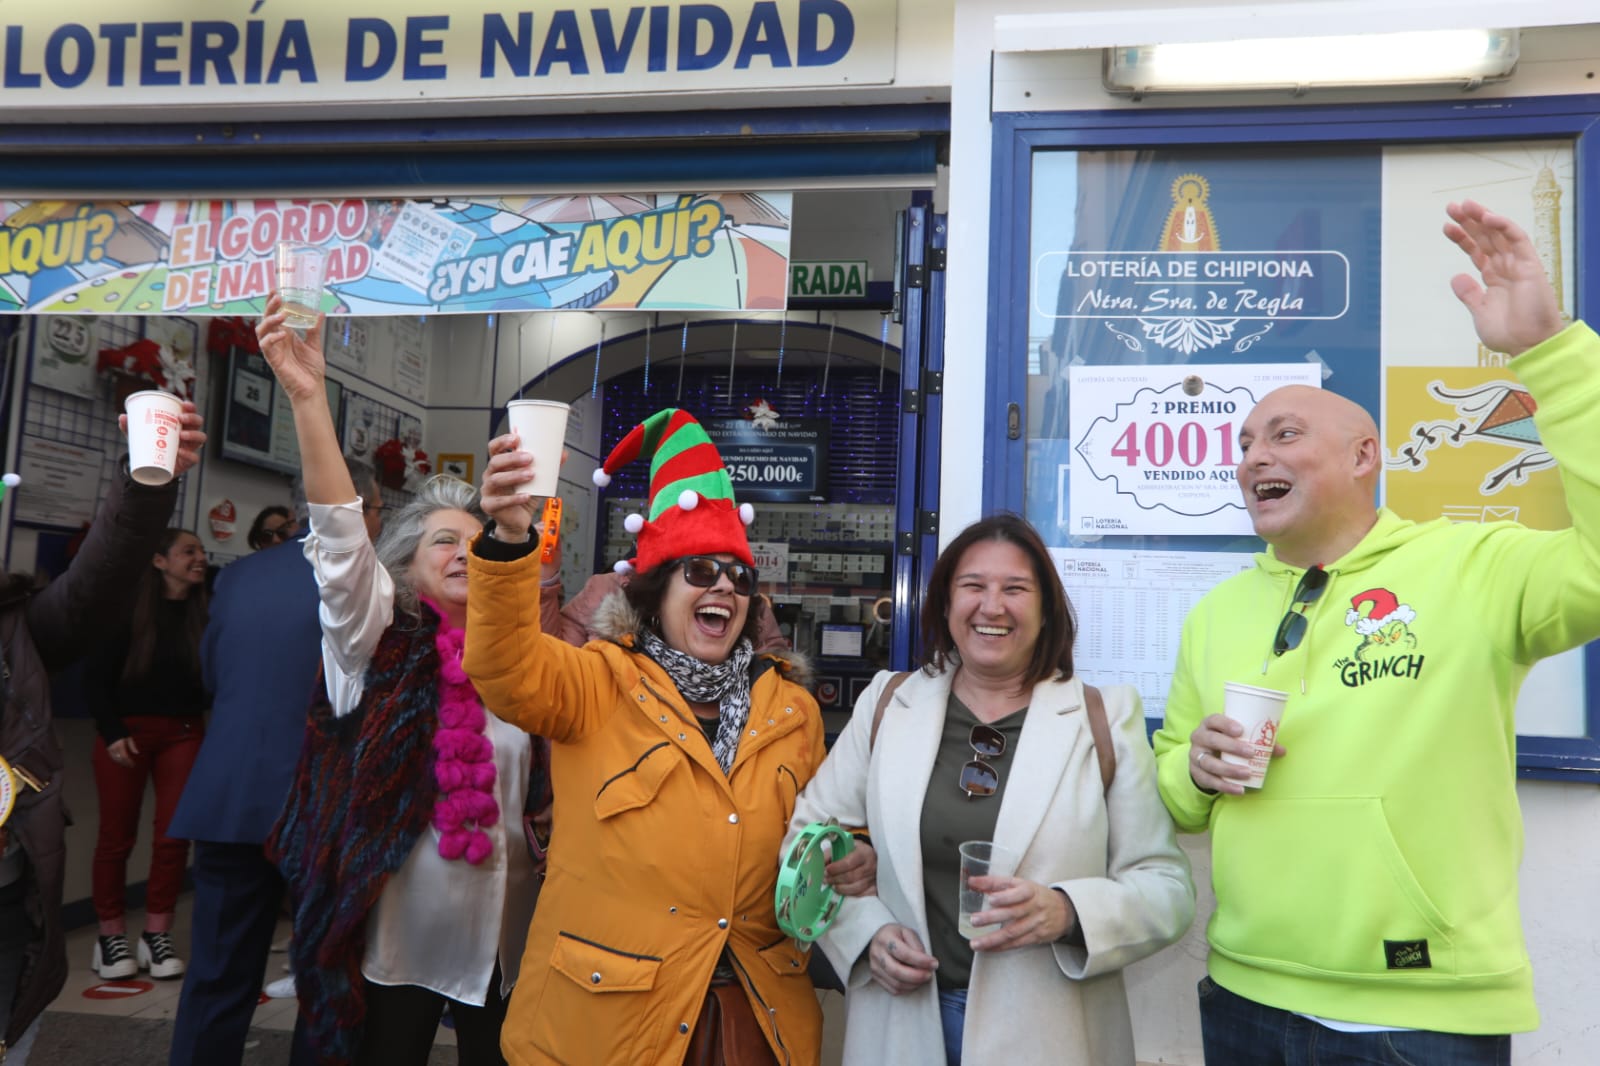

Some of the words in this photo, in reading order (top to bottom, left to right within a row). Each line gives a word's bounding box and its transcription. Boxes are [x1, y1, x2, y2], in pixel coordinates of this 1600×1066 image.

[4, 0, 318, 89] LOTERÍA
[345, 16, 450, 82] DE
[480, 0, 855, 79] NAVIDAD
[171, 223, 213, 267] EL
[220, 198, 367, 258] GORDO
[467, 254, 498, 290] SI
[500, 235, 573, 285] CAE
[572, 197, 721, 272] AQUÍ?
[165, 269, 210, 308] DE
[217, 244, 371, 301] NAAD
[789, 264, 863, 295] RADA
[1067, 256, 1161, 278] LOTERÍA
[1168, 260, 1198, 278] DE
[1204, 260, 1314, 278] CHIPIONA
[1077, 288, 1138, 312] Ntra.
[1141, 288, 1197, 313] Sra.
[1207, 290, 1228, 310] de
[1234, 288, 1304, 316] Regla
[1164, 401, 1237, 415] PREMIO
[1110, 421, 1240, 468] 4001
[1143, 470, 1206, 481] VENDIDO
[1209, 470, 1238, 482] AQU
[1332, 656, 1350, 669] The
[1340, 654, 1425, 688] GRINCH
